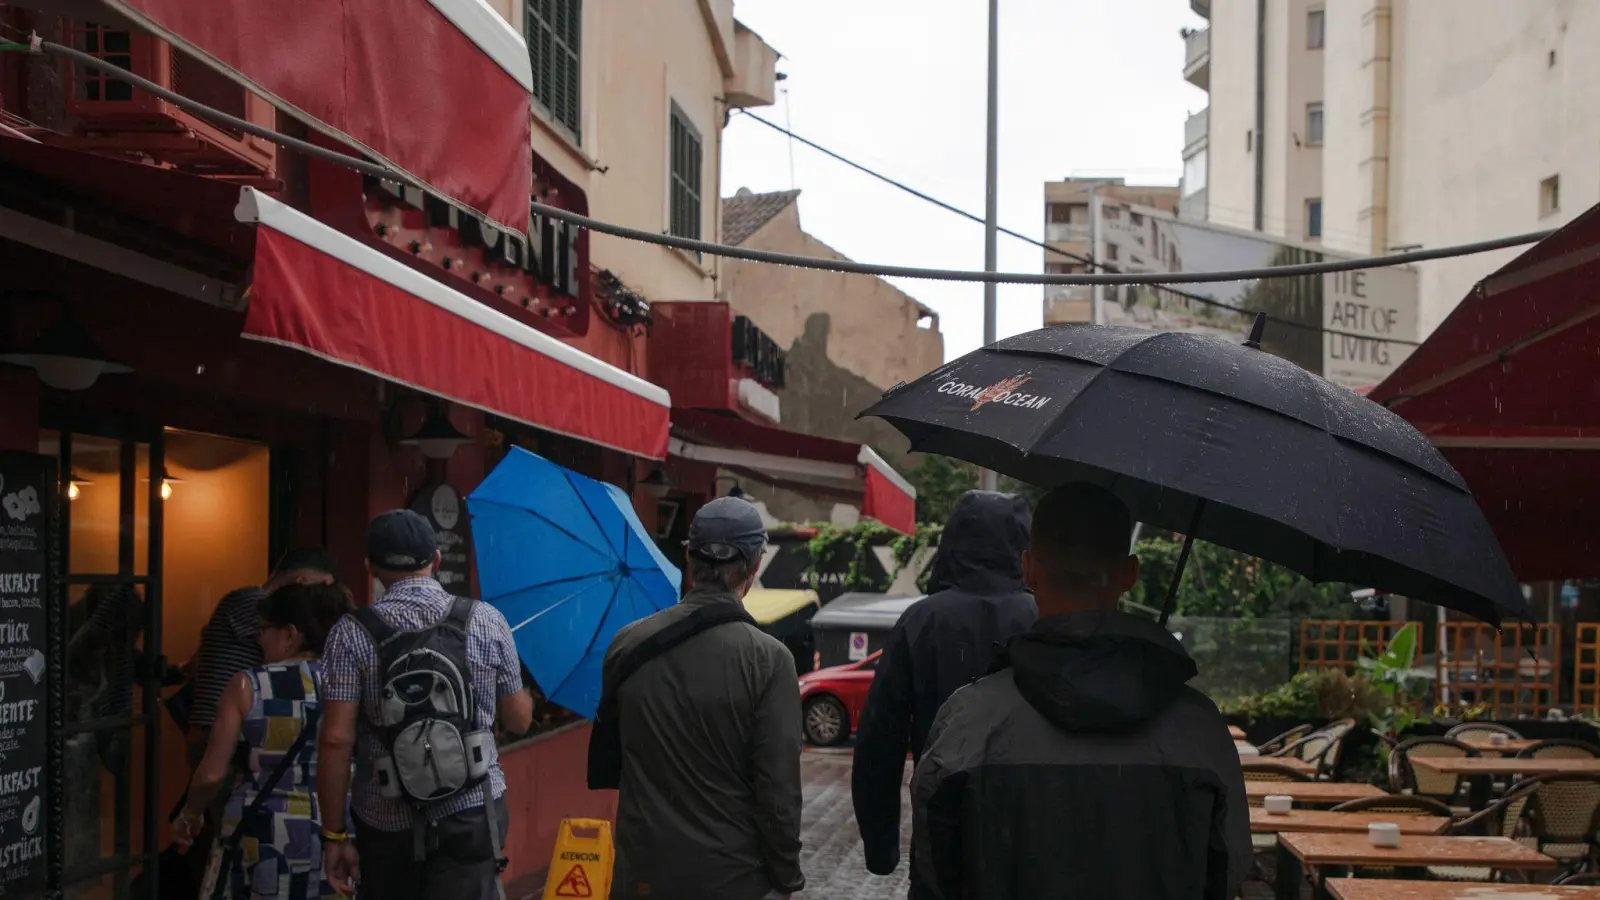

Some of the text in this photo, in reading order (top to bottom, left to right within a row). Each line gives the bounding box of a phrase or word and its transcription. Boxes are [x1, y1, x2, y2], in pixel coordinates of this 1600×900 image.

[1331, 301, 1399, 334] ART OF
[937, 381, 1052, 410] CORAL OCEAN
